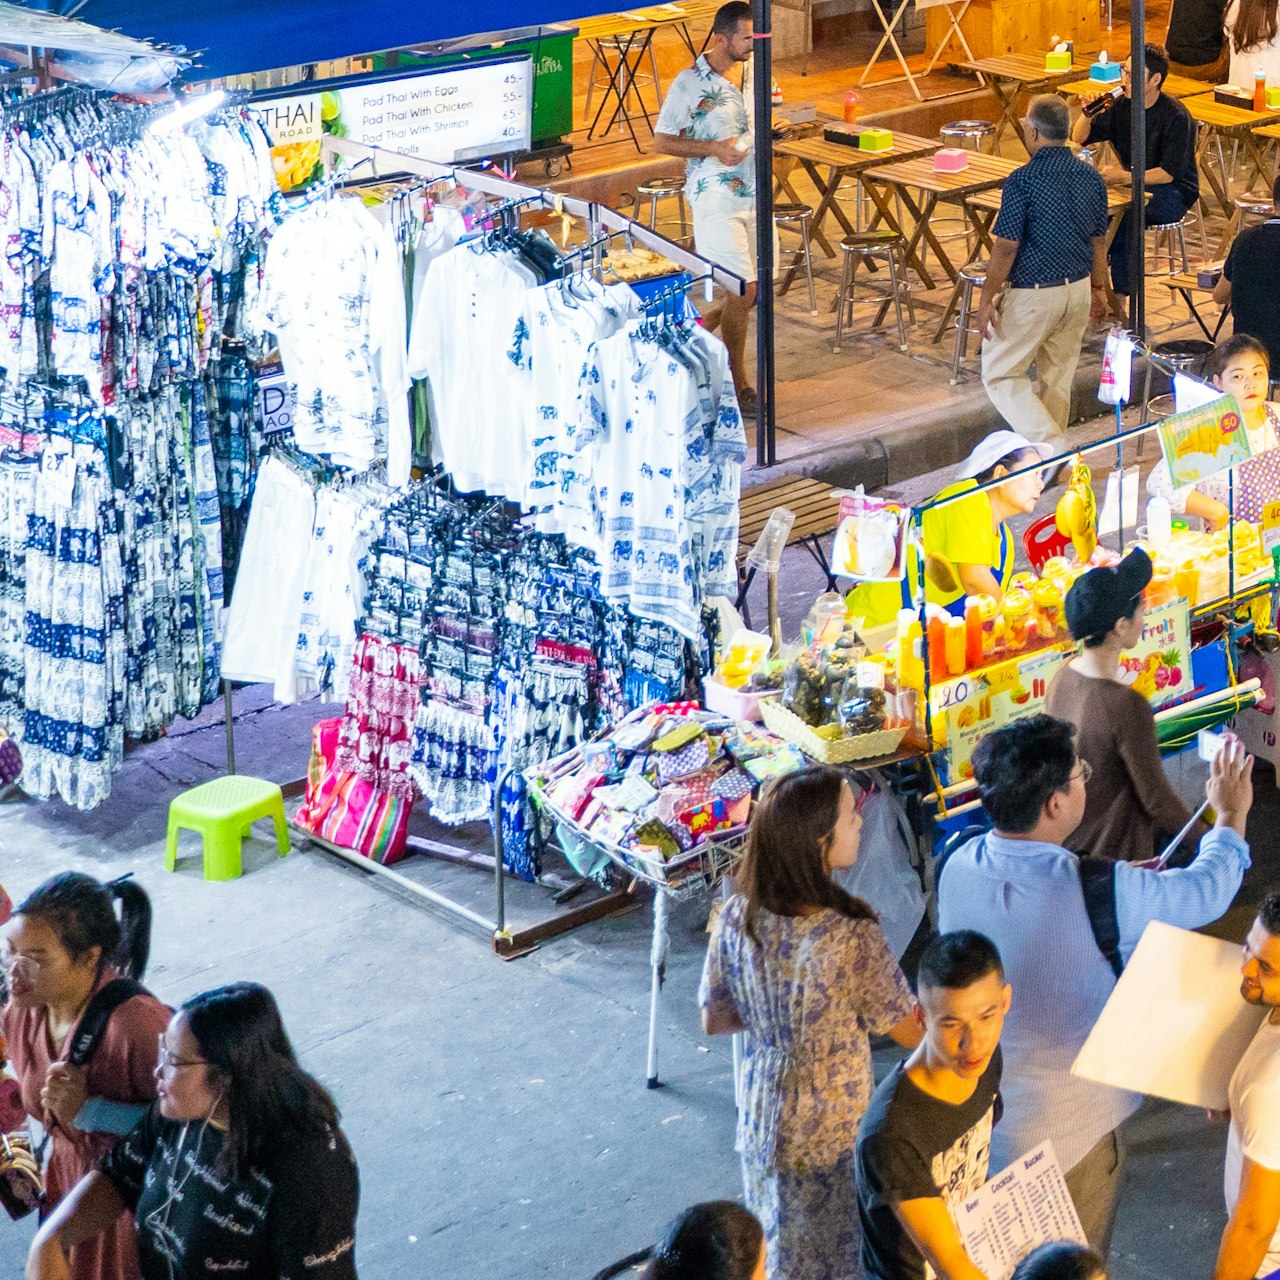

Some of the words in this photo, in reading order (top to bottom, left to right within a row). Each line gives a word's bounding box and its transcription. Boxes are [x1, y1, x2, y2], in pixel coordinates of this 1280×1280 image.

[363, 96, 383, 107] Pad
[386, 92, 408, 104] Thai
[411, 87, 432, 101] With
[434, 84, 459, 99] Eggs
[262, 101, 314, 129] THAI
[363, 114, 383, 126] Pad
[386, 110, 408, 123] Thai
[410, 106, 432, 119] With
[434, 99, 473, 116] Chicken
[280, 126, 313, 138] ROAD
[363, 133, 383, 145] Pad
[386, 129, 408, 141] Thai
[410, 124, 432, 137] With
[434, 118, 470, 136] Shrimps
[1223, 416, 1238, 429] 50
[960, 727, 979, 738] Mango
[979, 720, 996, 731] Juice
[1023, 1150, 1046, 1170] Bucket
[990, 1170, 1016, 1194] Cocktail
[965, 1198, 980, 1213] Beer
